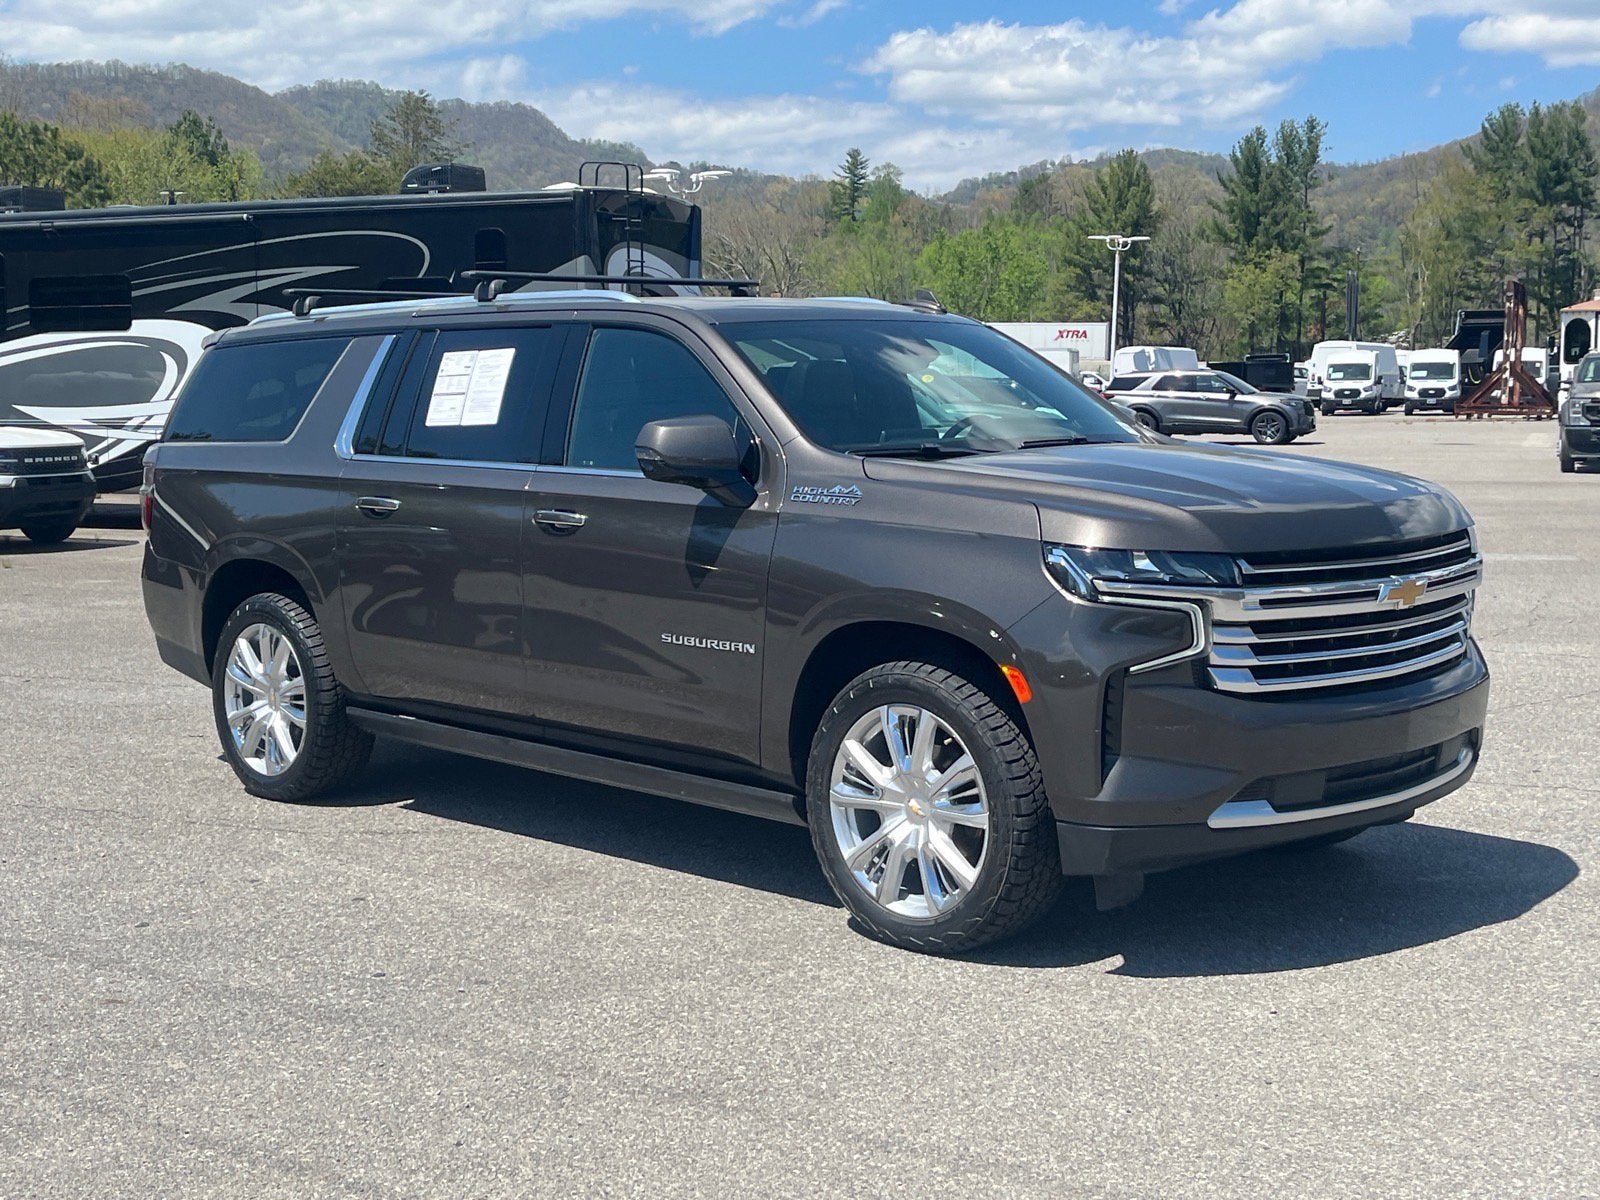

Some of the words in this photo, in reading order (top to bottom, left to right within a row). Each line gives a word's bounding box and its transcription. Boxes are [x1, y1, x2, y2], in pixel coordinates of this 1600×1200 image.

[1054, 329, 1088, 341] XTRA
[24, 455, 78, 463] BRONCO
[793, 486, 828, 495] HIGH
[790, 493, 862, 506] COUNTRY
[661, 632, 755, 654] SUBURBAN
